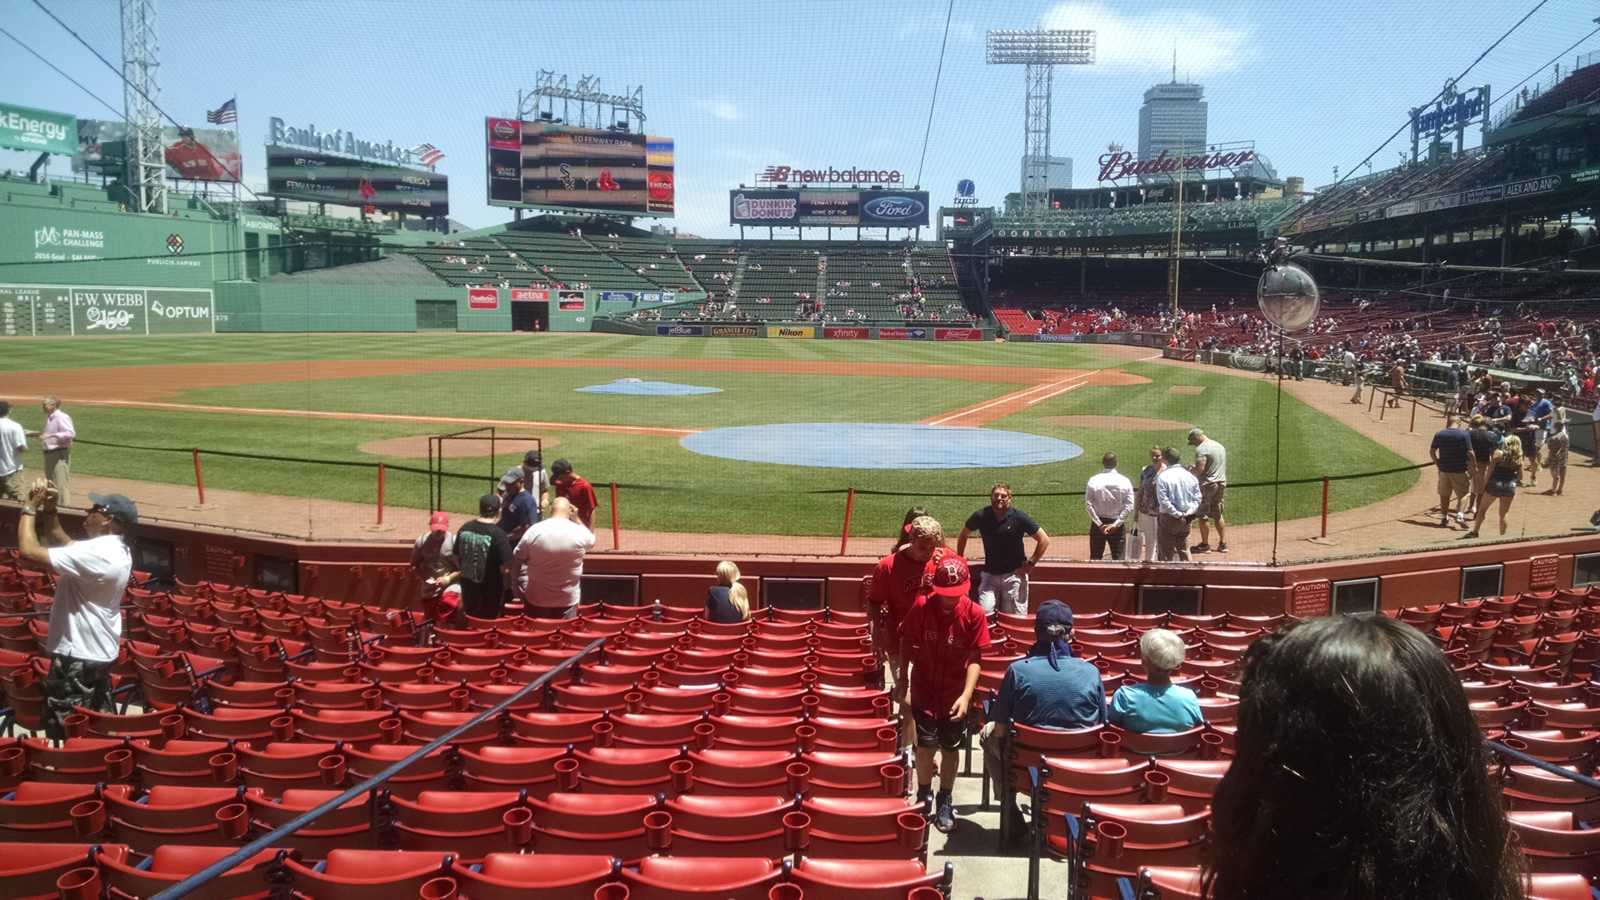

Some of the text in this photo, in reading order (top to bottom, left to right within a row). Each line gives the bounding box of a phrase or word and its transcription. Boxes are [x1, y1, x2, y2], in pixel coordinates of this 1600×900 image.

[269, 116, 411, 164] Bank of America
[574, 135, 584, 143] TO
[584, 136, 613, 145] FENWAY
[615, 140, 633, 149] PARK
[1097, 146, 1255, 182] Budweiser
[793, 169, 827, 183] new
[829, 165, 901, 183] balance
[286, 181, 315, 191] FENWAY
[649, 181, 672, 190] ENEOS
[1506, 184, 1522, 196] ALEX
[1523, 181, 1538, 193] AND
[751, 208, 795, 219] DONUTS
[876, 200, 913, 216] Ford
[63, 229, 104, 240] PAN-MASS
[63, 238, 104, 248] CHALLENGE
[35, 252, 50, 260] 2016
[74, 293, 144, 307] F.W. WEBB
[516, 291, 544, 300] aetna
[643, 293, 661, 302] NESN
[165, 306, 209, 318] OPTUM
[668, 326, 692, 335] jetBlue
[712, 327, 742, 336] GRANITE
[742, 327, 757, 336] CITY
[778, 328, 804, 337] Nikon
[833, 329, 859, 338] xfinity
[944, 564, 959, 585] B
